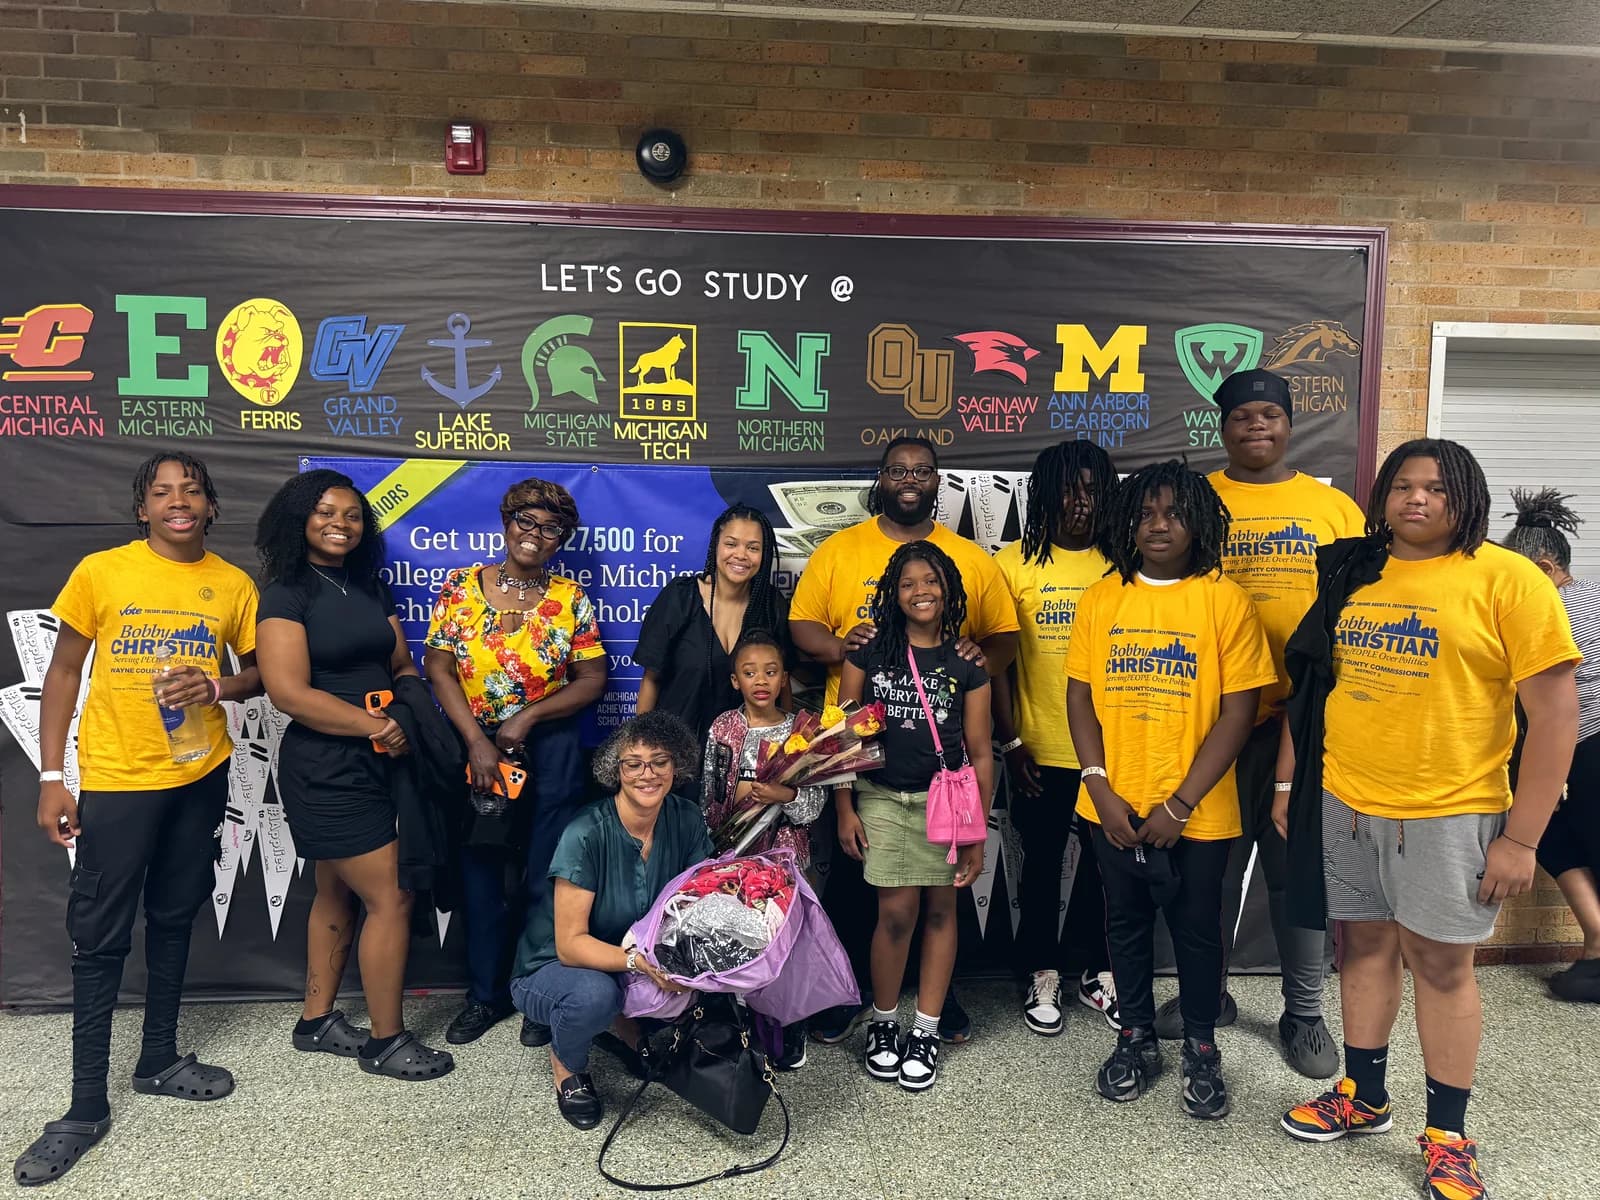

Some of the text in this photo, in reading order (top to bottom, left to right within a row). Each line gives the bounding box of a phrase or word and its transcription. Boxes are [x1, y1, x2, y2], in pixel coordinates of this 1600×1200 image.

[541, 264, 854, 302] LET'S GO STUDY @
[115, 294, 209, 397] E
[309, 315, 406, 393] GV
[1054, 324, 1147, 392] M
[735, 330, 831, 412] N
[866, 322, 955, 420] OU
[1285, 375, 1344, 393] STERN
[0, 395, 98, 415] CENTRAL
[122, 400, 206, 418] EASTERN
[323, 397, 397, 416] GRAND
[631, 397, 686, 412] 1885
[957, 396, 1039, 415] SAGINAW
[1047, 392, 1150, 411] ANN ARBOR
[1292, 394, 1348, 413] HIGAN
[0, 417, 104, 437] MICHIGAN
[118, 419, 213, 437] MICHIGAN
[241, 410, 302, 431] FERRIS
[327, 416, 403, 437] VALLEY
[438, 412, 493, 432] LAKE
[524, 412, 611, 430] MICHIGAN
[737, 419, 825, 437] NORTHERN
[960, 413, 1029, 433] VALLEY
[1050, 412, 1150, 430] DEARBORN
[1183, 410, 1221, 428] WAY
[545, 430, 598, 448] STATE
[613, 421, 707, 441] MICHIGAN
[1189, 430, 1223, 447] STA
[415, 431, 511, 451] SUPERIOR
[739, 435, 826, 453] MICHIGAN
[640, 441, 690, 461] TECH
[371, 483, 409, 520] NIORS
[410, 526, 684, 558] Get up 27,500 for
[1228, 529, 1265, 543] obby
[1222, 540, 1316, 557] HRISTIAN
[1290, 555, 1314, 565] Politic
[378, 560, 704, 594] olleg he Michi
[119, 602, 143, 616] Vote
[120, 623, 171, 641] Bobby
[1338, 615, 1379, 634] obby
[1109, 643, 1149, 658] Bobby
[1335, 629, 1439, 660] HRISTIAN
[1105, 657, 1197, 680] CHRISTIAN
[1398, 655, 1429, 667] Politics
[1370, 663, 1430, 679] COMMISSIONER
[894, 674, 939, 690] MAKE
[873, 685, 954, 708] EVERYTHING
[4, 689, 40, 743] #IAppli
[597, 704, 637, 714] ACHIEVEM
[235, 742, 253, 801] #IApplie
[258, 809, 265, 818] to
[266, 806, 288, 873] #IApplied
